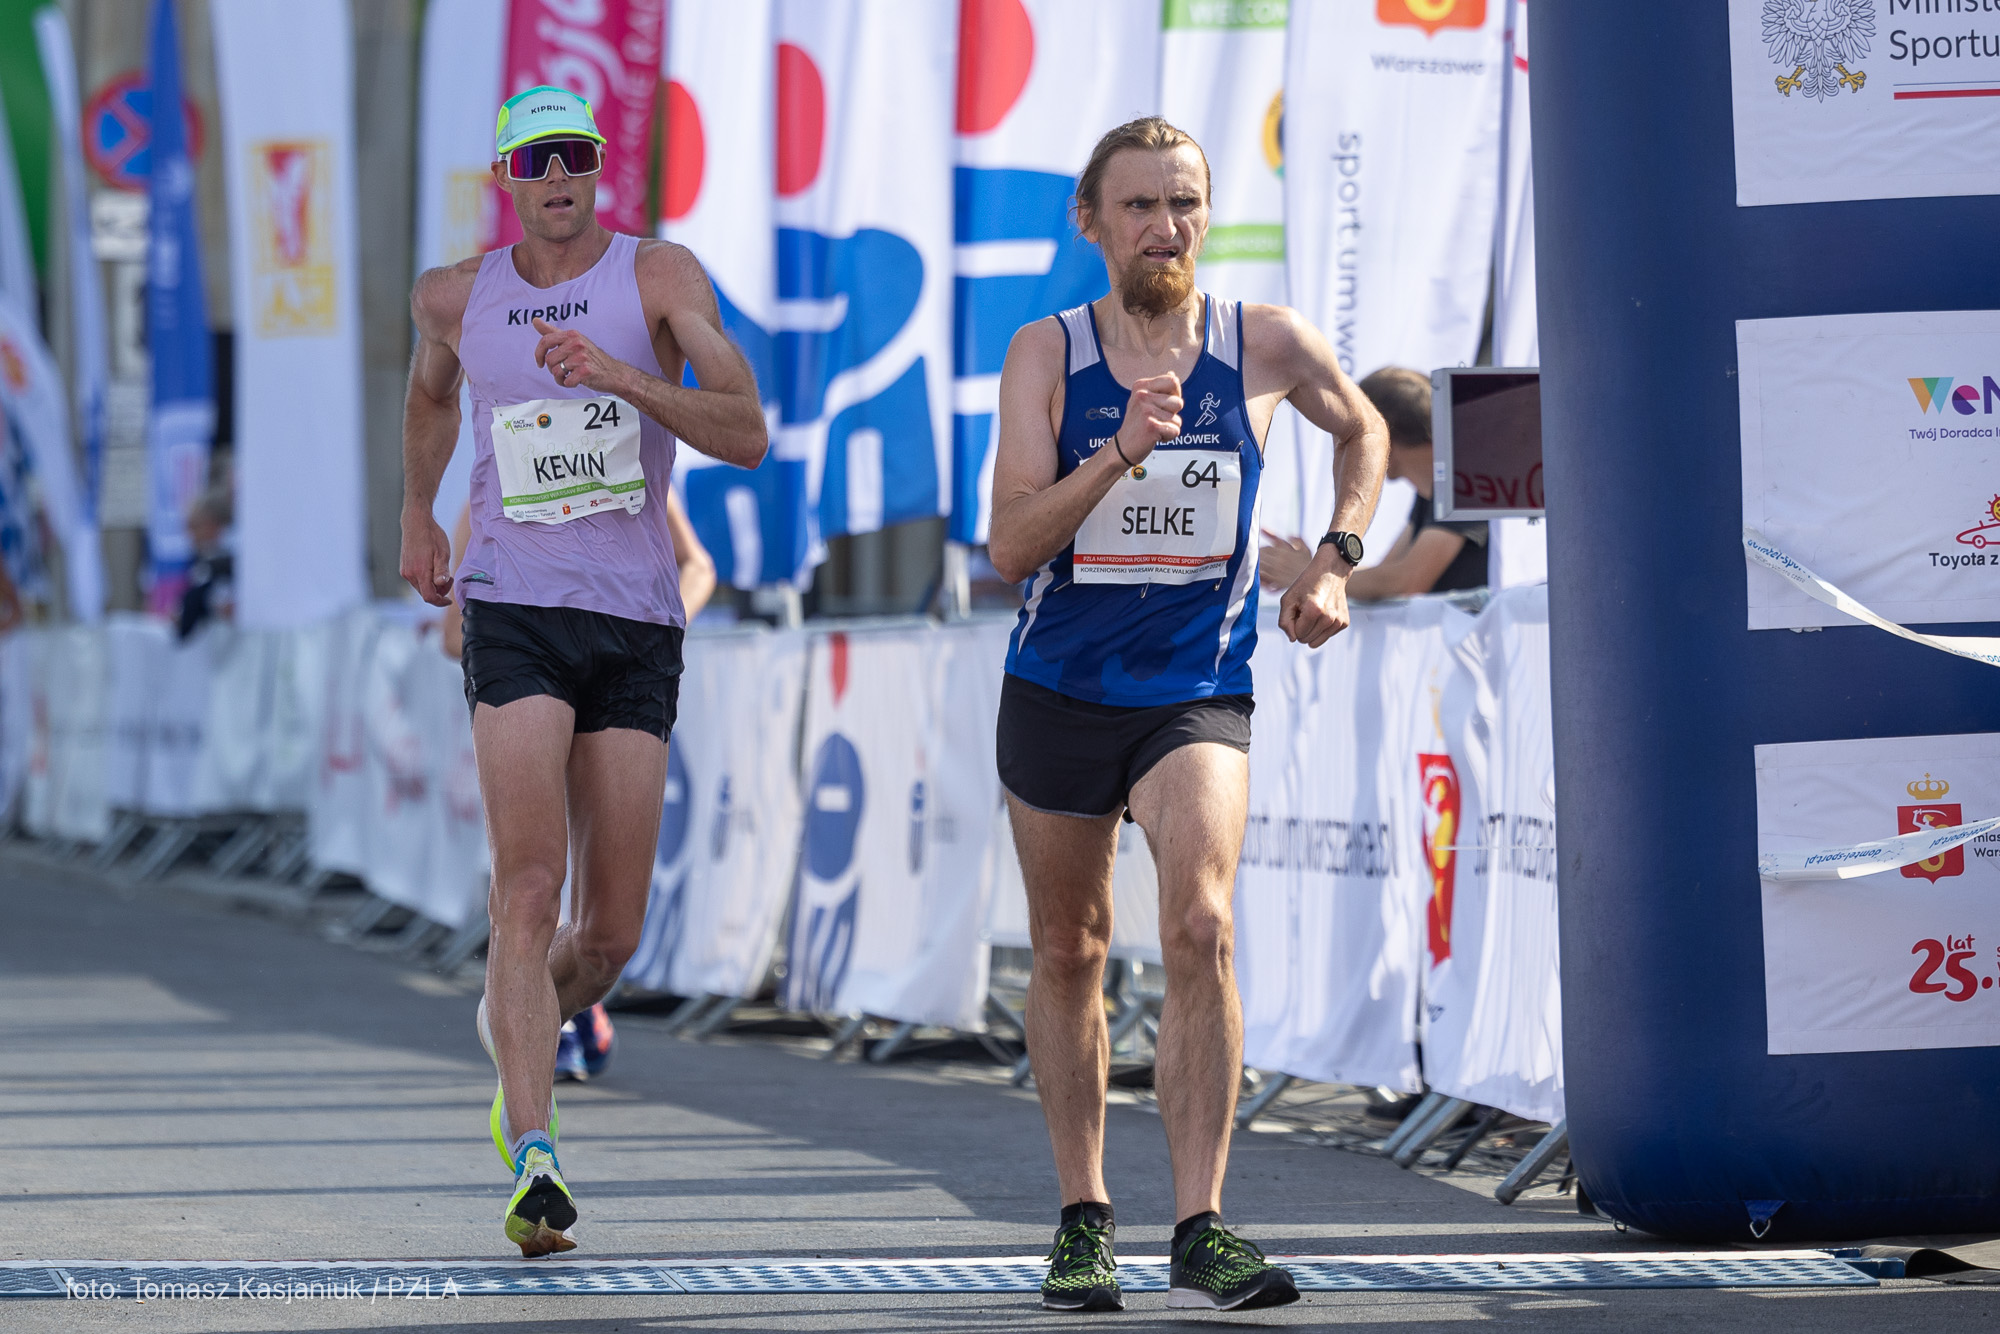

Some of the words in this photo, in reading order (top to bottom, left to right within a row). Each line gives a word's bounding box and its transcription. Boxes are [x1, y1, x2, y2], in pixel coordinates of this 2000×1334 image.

[1889, 29, 2000, 66] Sportu
[530, 105, 566, 114] KIPRUN
[1331, 132, 1361, 377] sport.um.wa
[508, 300, 588, 325] KIPRUN
[583, 401, 621, 430] 24
[1909, 428, 1937, 441] Twój
[1940, 427, 1992, 438] Doradca
[533, 451, 605, 484] KEVIN
[1181, 460, 1221, 488] 64
[1121, 506, 1196, 536] SELKE
[1928, 552, 1986, 570] Toyota
[1804, 848, 1882, 868] domtel-sport.pl
[1947, 934, 1976, 952] lat
